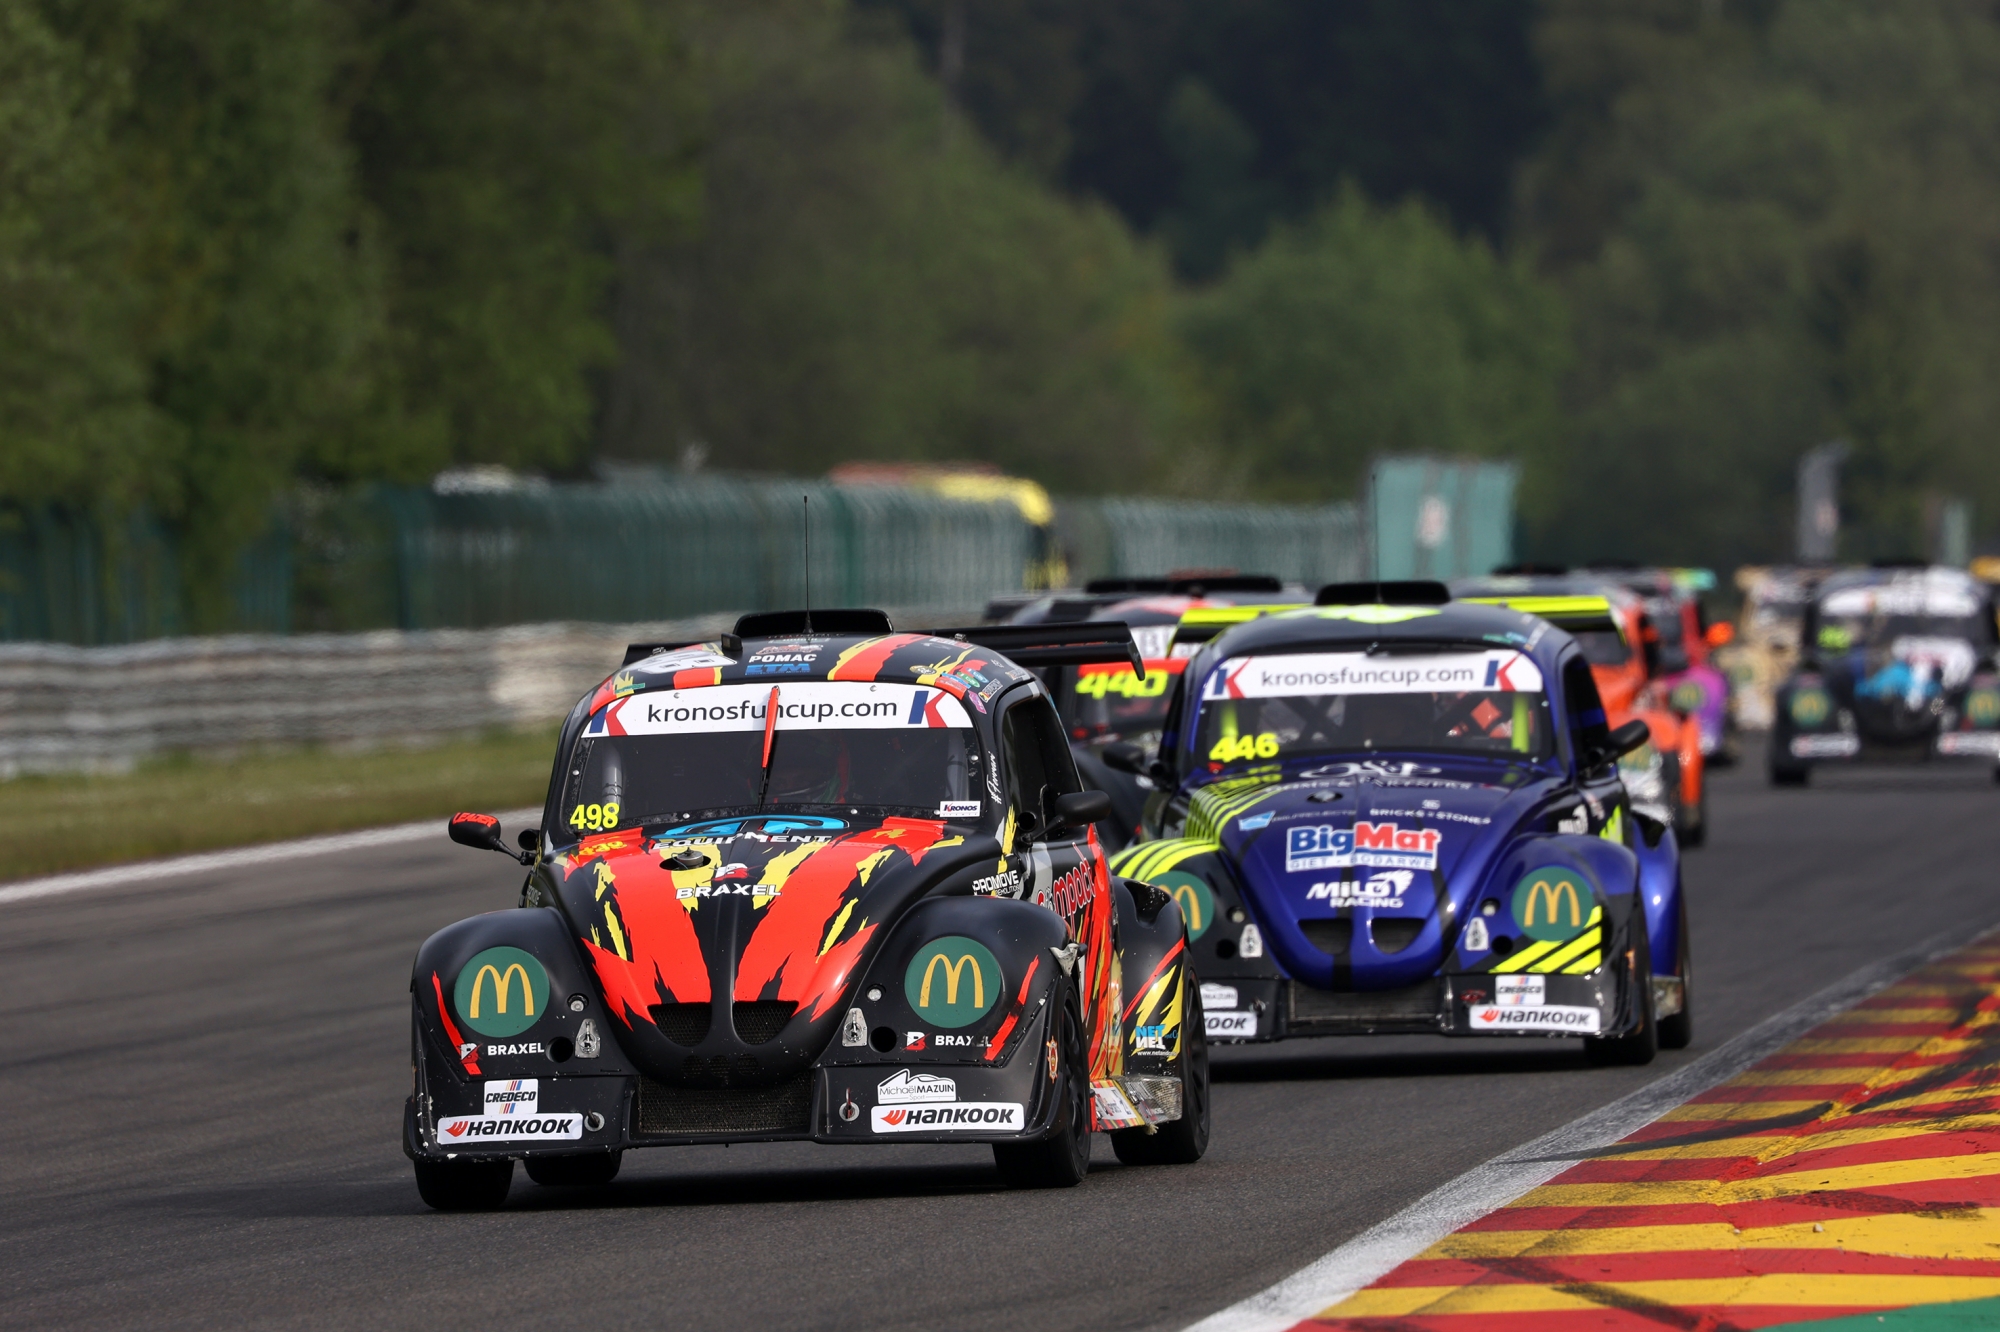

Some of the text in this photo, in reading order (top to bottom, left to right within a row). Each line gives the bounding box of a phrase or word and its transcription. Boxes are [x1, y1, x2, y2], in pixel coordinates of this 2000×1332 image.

[749, 653, 817, 664] POMAC
[745, 663, 811, 674] ETM
[1075, 669, 1168, 699] 440
[1261, 667, 1474, 690] kronosfuncup.com
[647, 699, 897, 724] kronosfuncup.com
[1209, 733, 1279, 762] 446
[570, 802, 621, 829] 498
[943, 803, 978, 812] KRONOS
[1370, 808, 1424, 819] BRICKS
[1436, 811, 1491, 826] STONES
[652, 832, 833, 851] EQUIPMENT
[1289, 822, 1442, 854] BigMat
[675, 883, 782, 901] BRAXEL
[972, 870, 1020, 896] PROMOVE
[1330, 898, 1404, 908] RACING
[487, 1043, 545, 1056] BRAXEL
[485, 1091, 536, 1103] CREDECO
